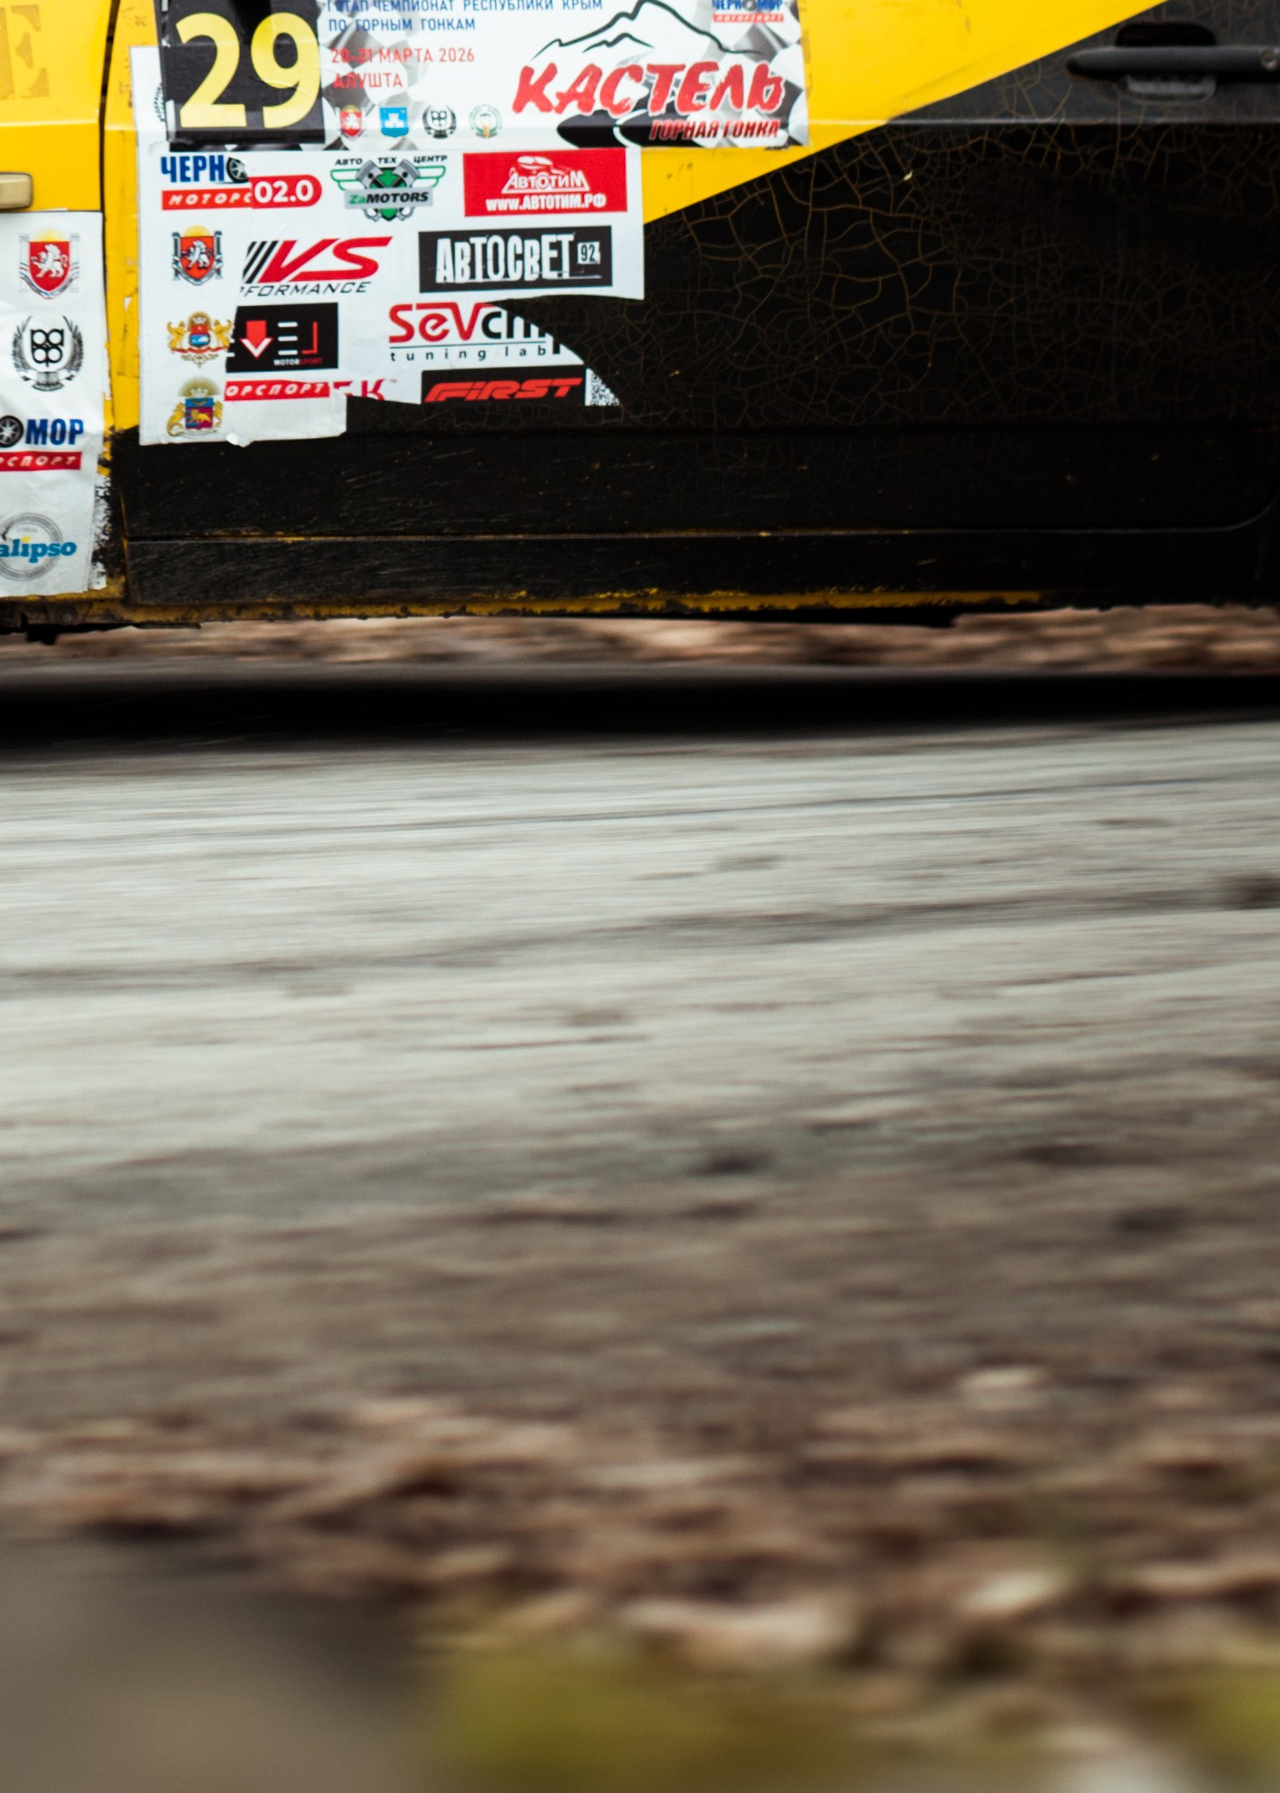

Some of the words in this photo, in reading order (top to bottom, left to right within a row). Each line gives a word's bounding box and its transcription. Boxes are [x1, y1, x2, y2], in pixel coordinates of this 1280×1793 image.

[373, 0, 454, 12] ЧЕМПИОНАТ
[329, 19, 347, 32] ПО
[355, 19, 413, 32] ГОРНЫМ
[421, 17, 475, 31] ГОНКАМ
[379, 48, 433, 62] МАРТА
[439, 47, 475, 62] 2026
[175, 12, 321, 129] 29
[332, 72, 404, 89] АЛУШТА
[511, 61, 785, 117] КАСТЕЛЬ
[649, 119, 719, 140] ГОРНАЯ
[722, 118, 780, 139] ГОНКА
[335, 157, 363, 166] АВТО
[378, 156, 397, 165] ТЕХ
[413, 155, 448, 164] ЦЕНТР
[349, 192, 428, 205] ZaMOTORS
[486, 194, 606, 211] www.АВТОТИМ.РФ
[257, 236, 393, 284] VS
[580, 244, 597, 262] 92
[390, 348, 487, 362] tuning
[505, 345, 547, 357] lab
